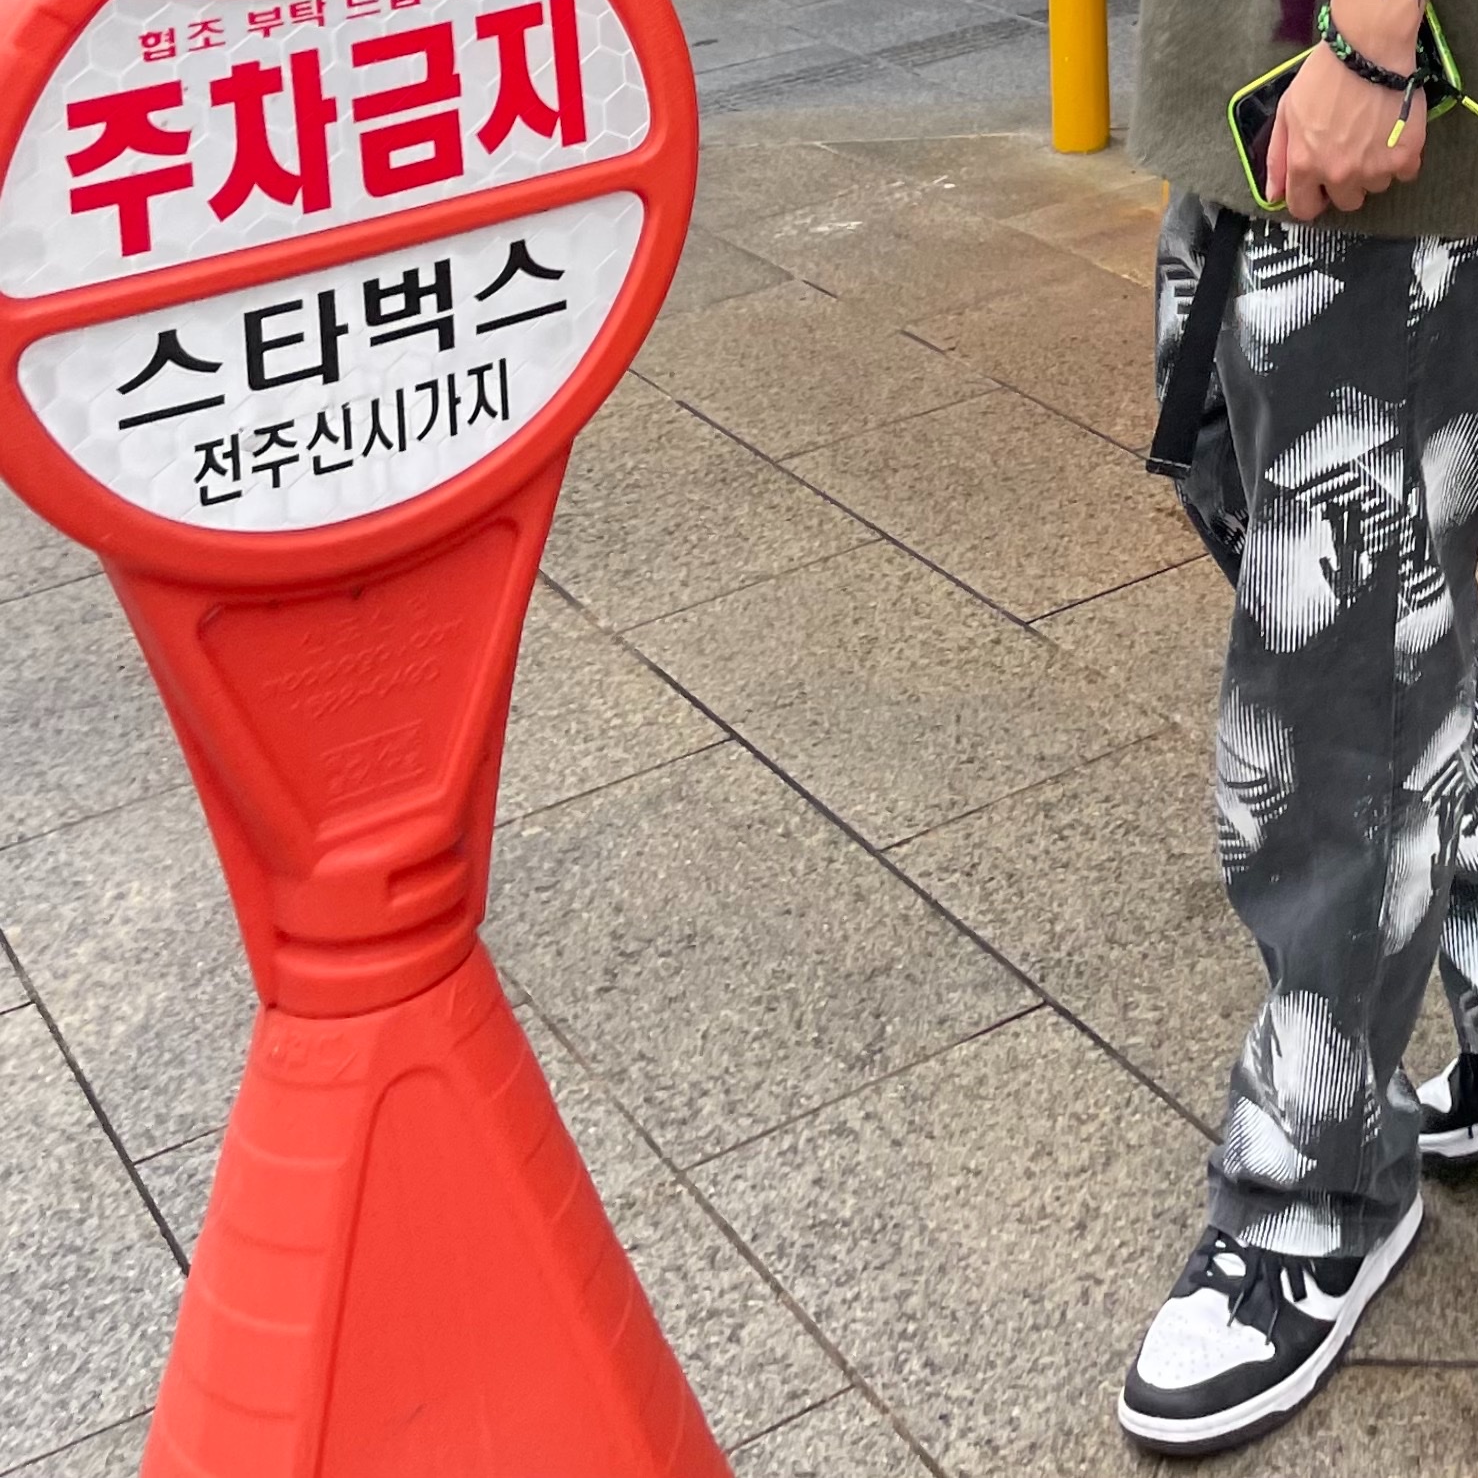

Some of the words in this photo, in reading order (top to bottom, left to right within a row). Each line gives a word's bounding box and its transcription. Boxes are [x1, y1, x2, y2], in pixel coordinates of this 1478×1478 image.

[138, 17, 225, 62] 협조
[117, 239, 568, 431] 스타벅스
[193, 358, 512, 507] 전주신시가지
